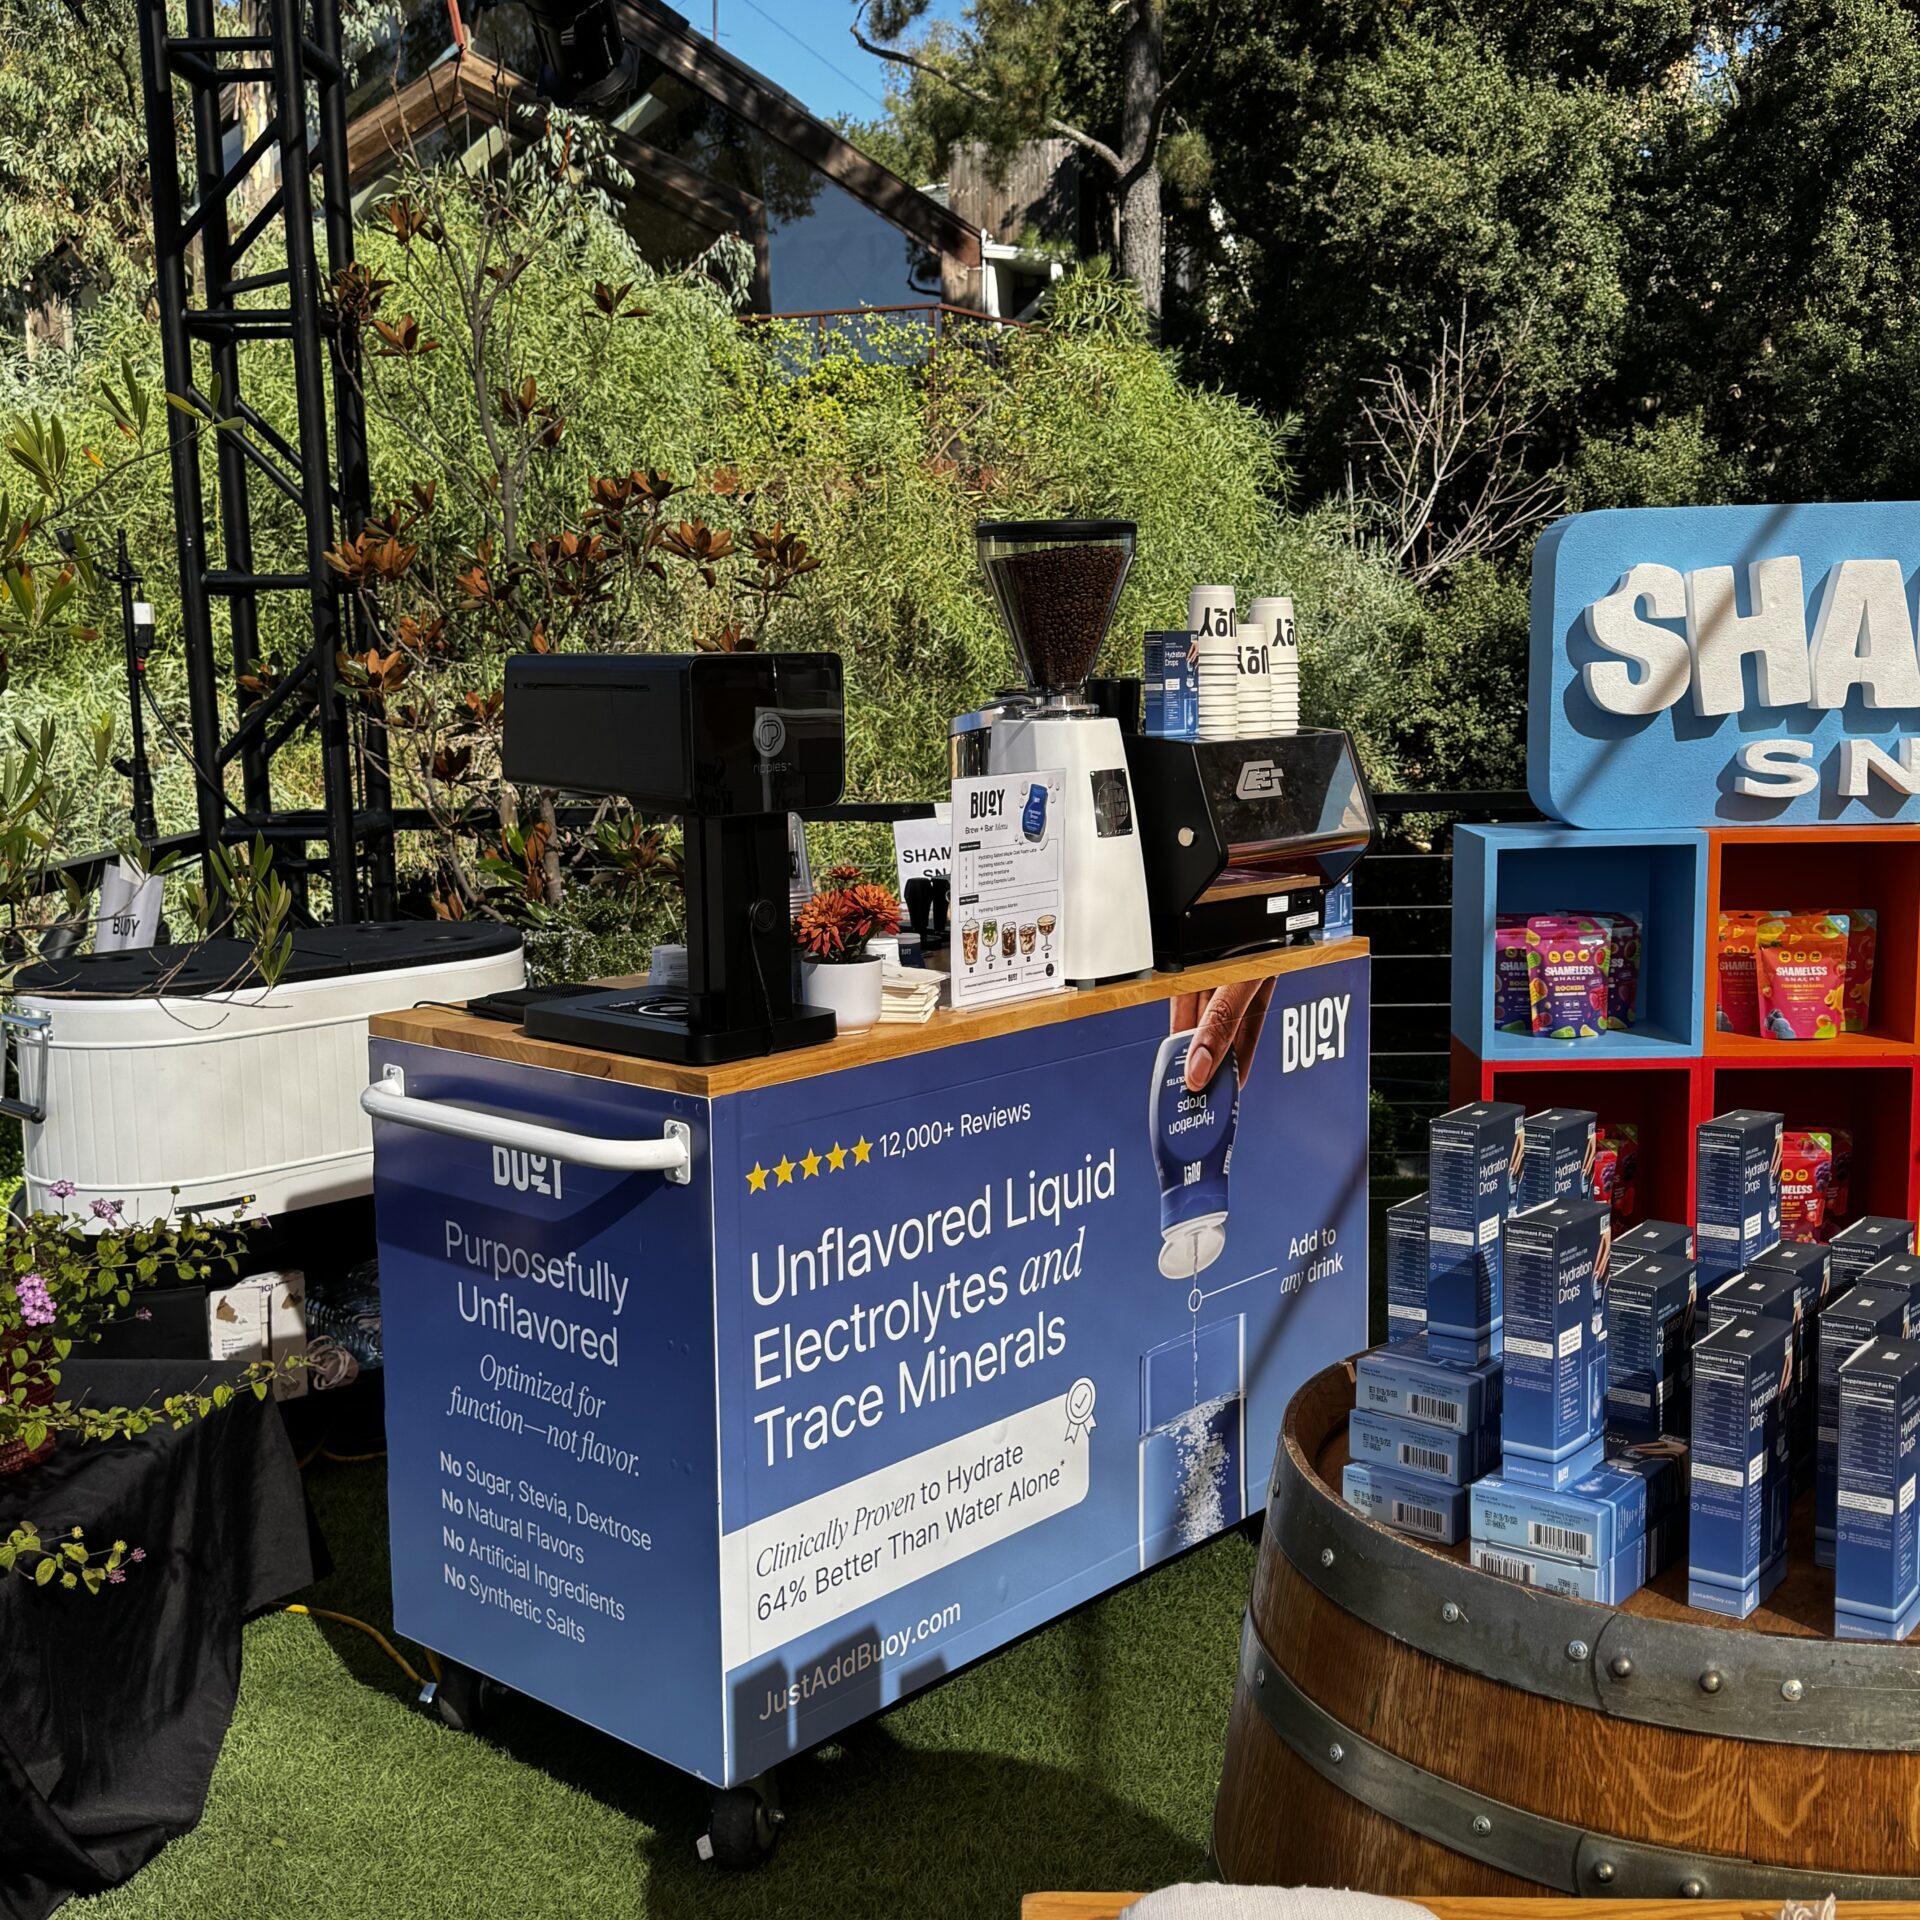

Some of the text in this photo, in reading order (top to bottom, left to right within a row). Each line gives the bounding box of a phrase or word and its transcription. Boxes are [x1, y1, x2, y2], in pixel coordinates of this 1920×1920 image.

[1582, 555, 1920, 717] SHA
[970, 789, 1006, 819] BUOY
[1545, 965, 1594, 977] SHAMELESS
[1776, 966, 1828, 977] SHAMELESS
[1282, 993, 1351, 1075] BUOY
[1169, 1110, 1215, 1135] Hydration
[1177, 1094, 1207, 1113] Drops
[879, 1101, 1031, 1159] 12,000+ Reviews
[1480, 1157, 1509, 1180] Hydration
[1480, 1179, 1498, 1196] Drops
[1555, 1160, 1582, 1180] Hydration
[1555, 1179, 1572, 1194] Drops
[1745, 1160, 1769, 1180] Hydration
[1745, 1179, 1760, 1194] Drops
[751, 1147, 1116, 1306] Unflavored Liquid
[1288, 1227, 1336, 1261] Add to
[1506, 1227, 1553, 1239] Supplement Facts
[445, 1220, 629, 1316] Purposefully
[1280, 1252, 1344, 1295] any drink
[1559, 1261, 1592, 1287] Hydration
[754, 1225, 1086, 1390] Electrolytes and
[1559, 1284, 1580, 1304] Drops
[458, 1282, 618, 1366] Unflavored
[1695, 1352, 1745, 1366] Supplement Facts
[480, 1354, 606, 1419] Optimized for
[754, 1310, 1067, 1468] Trace Minerals
[1750, 1383, 1778, 1413] Hydration
[1842, 1377, 1895, 1390] Supplement Facts
[577, 1431, 640, 1478] flavor.
[440, 1450, 652, 1551] No Sugar, Stevia, Dextrose
[756, 1444, 1024, 1578] Clinically Proven to Hydrate
[441, 1488, 585, 1564] No Natural Flavors
[443, 1526, 625, 1621] No Artificial Ingredients
[757, 1575, 808, 1621] 64%
[816, 1545, 882, 1595] Better
[888, 1520, 939, 1560] Than
[945, 1491, 1002, 1534] Water
[444, 1563, 585, 1643] No Synthetic Salts
[759, 1601, 961, 1721] JustAddBuoy.com
